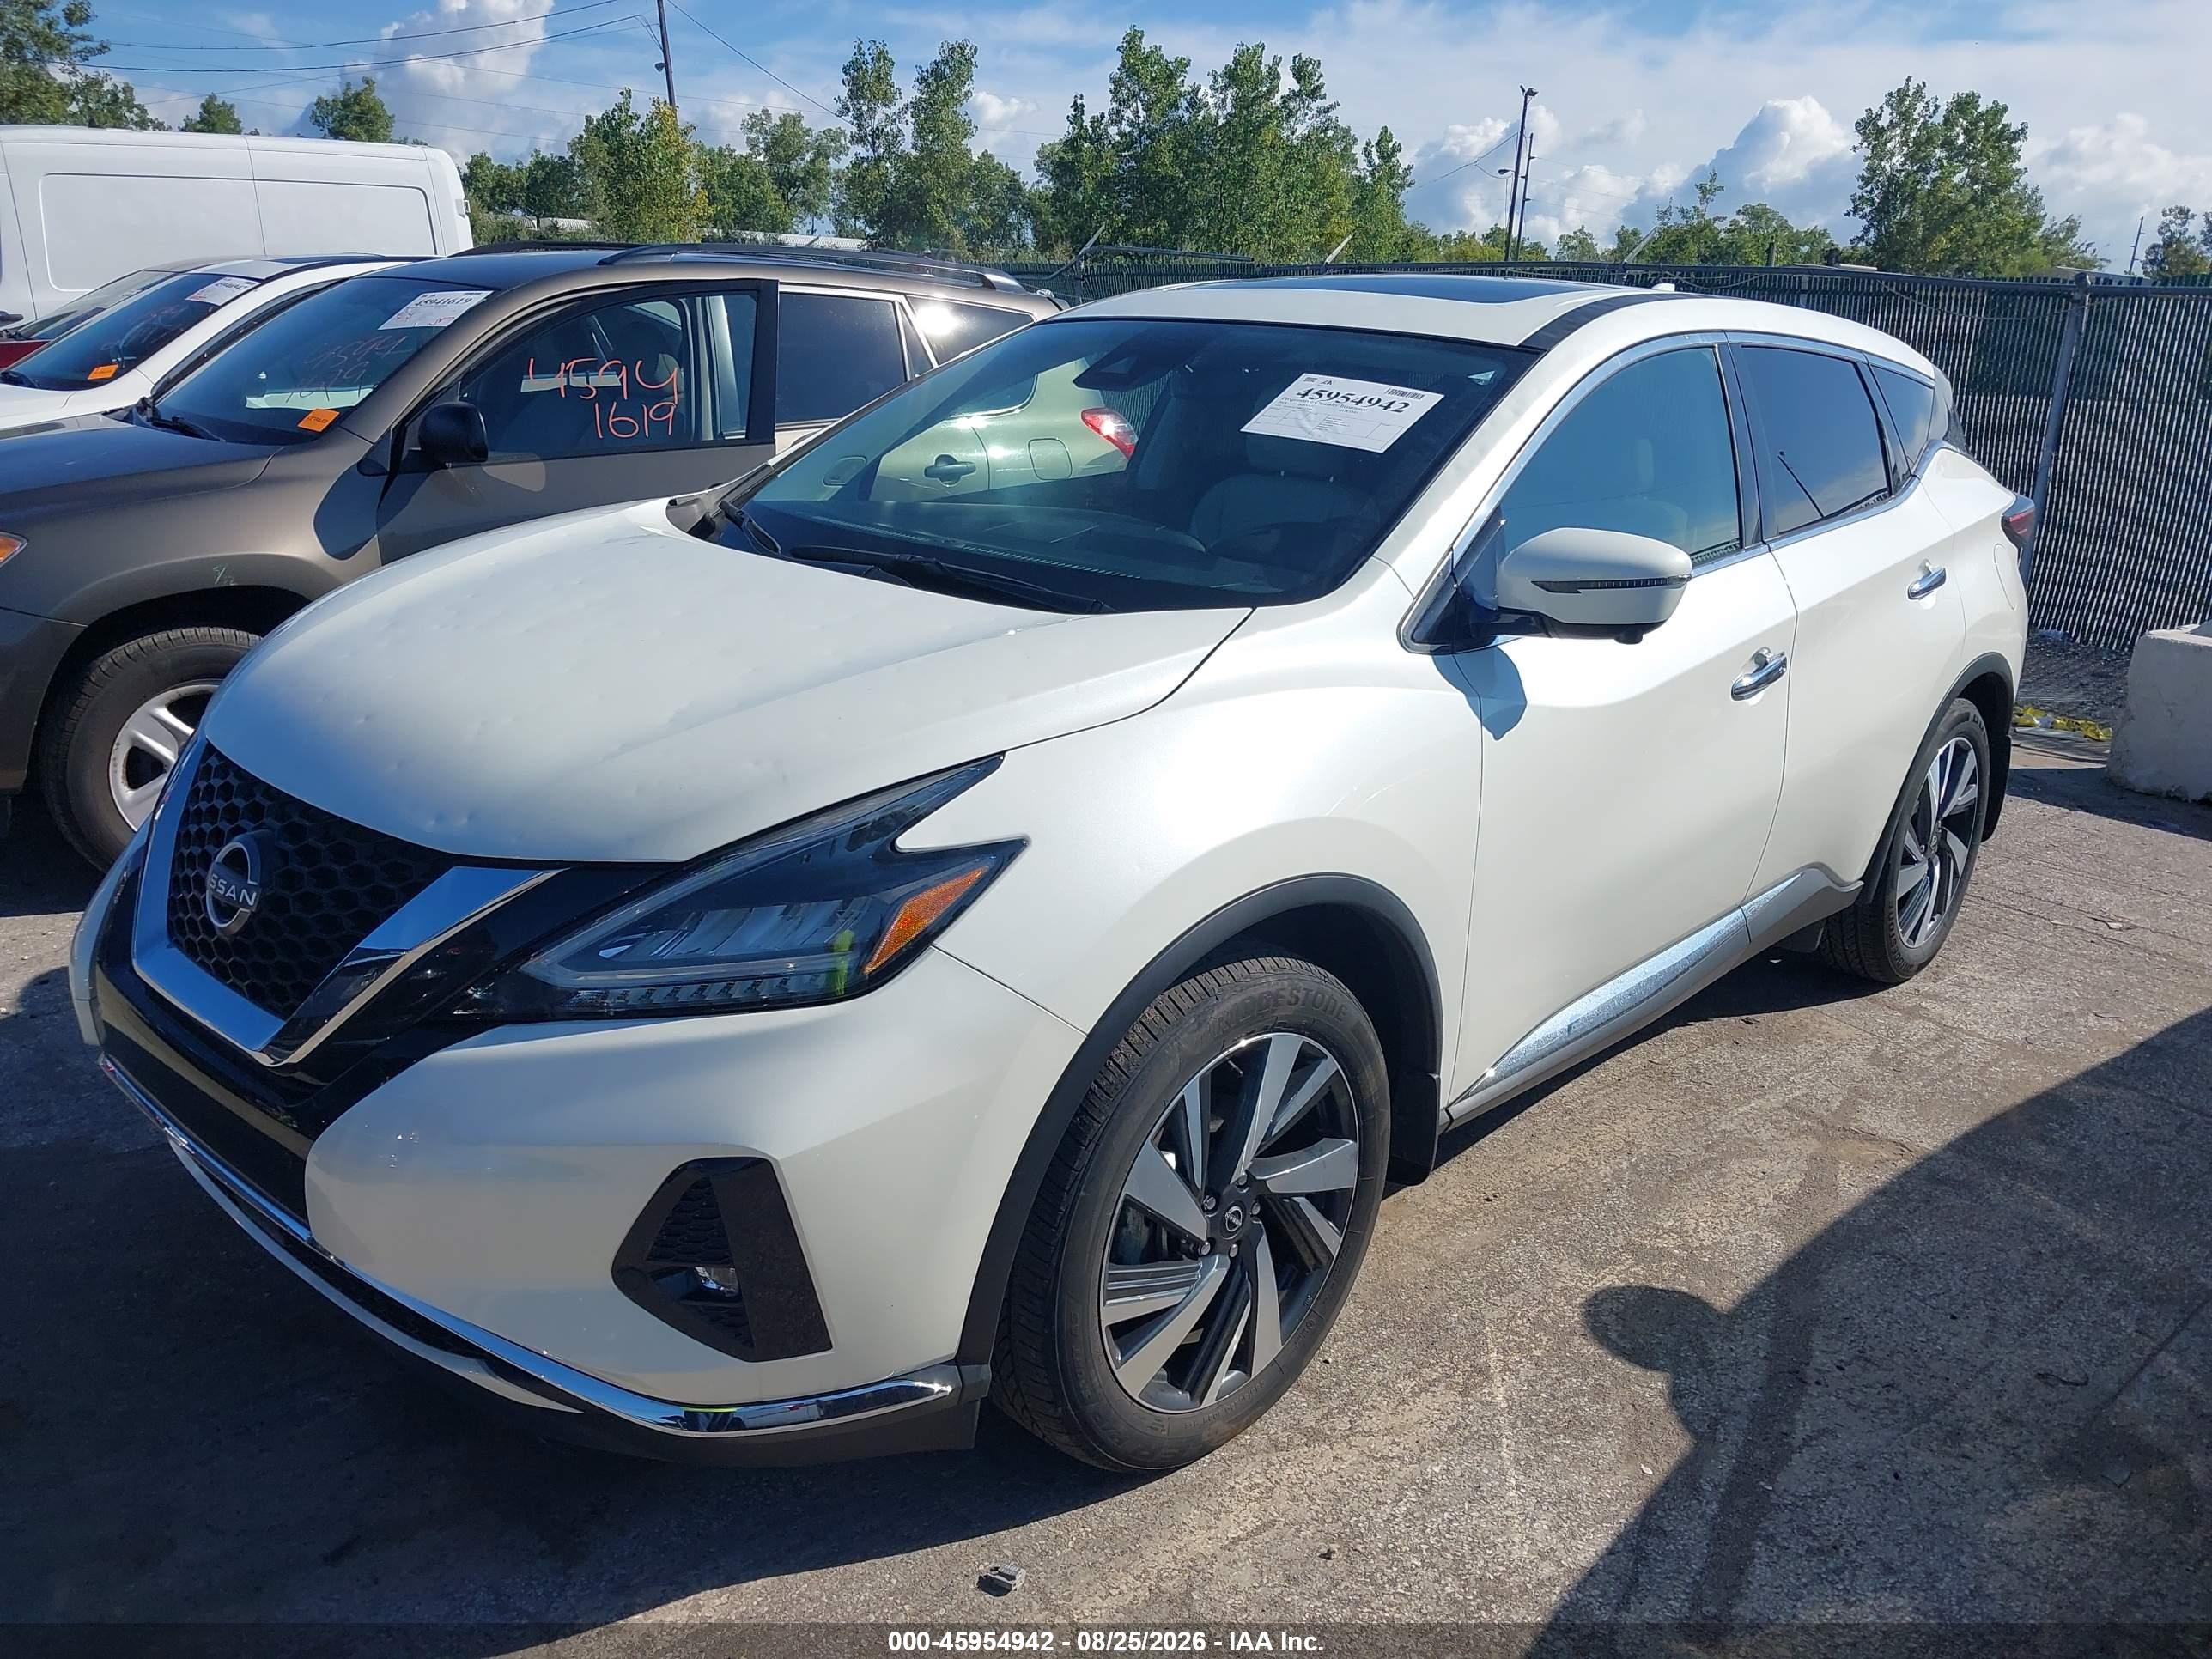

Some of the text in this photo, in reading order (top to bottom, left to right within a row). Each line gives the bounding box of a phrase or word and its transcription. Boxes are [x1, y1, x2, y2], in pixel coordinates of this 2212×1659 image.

[528, 357, 678, 404] 4594
[1296, 387, 1410, 413] 45954942
[595, 400, 677, 439] 1619
[209, 873, 257, 906] SSAN
